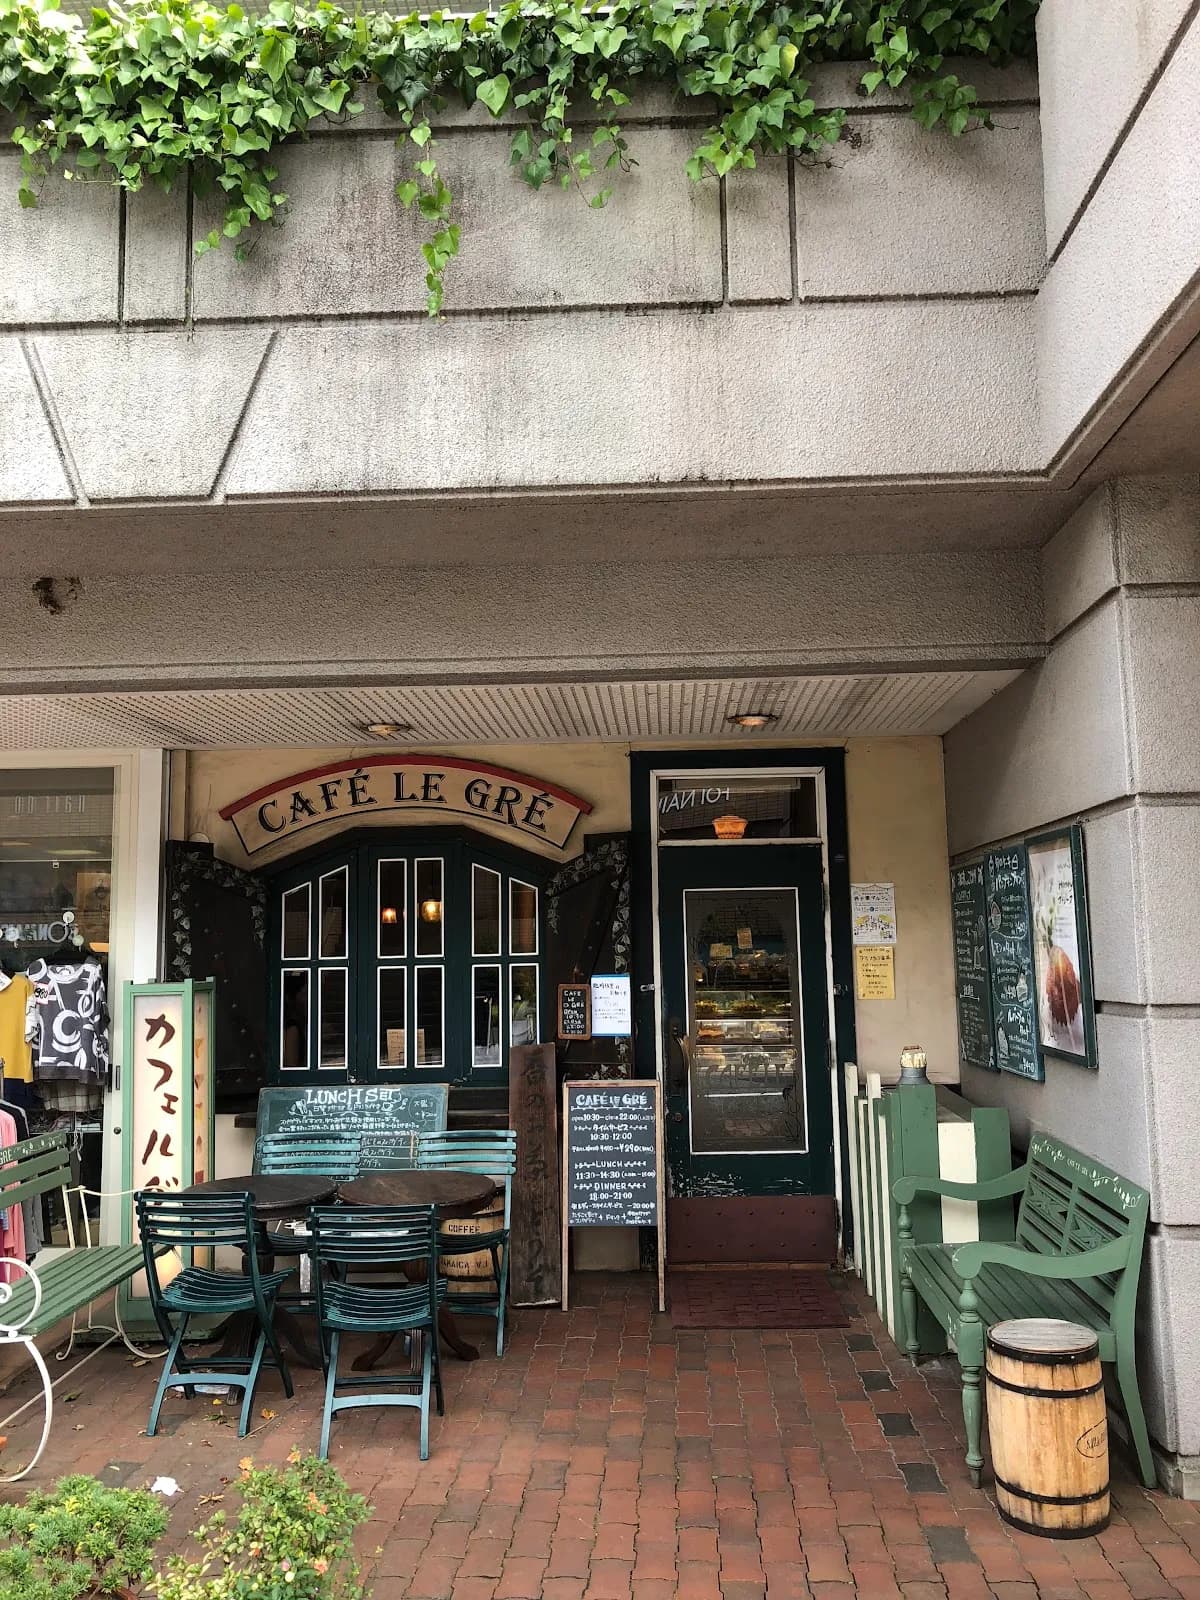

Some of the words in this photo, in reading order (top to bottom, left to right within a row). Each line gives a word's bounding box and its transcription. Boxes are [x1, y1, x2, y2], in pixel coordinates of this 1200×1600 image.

[257, 768, 378, 834] CAFÉ
[393, 771, 447, 804] LE
[464, 777, 555, 833] GRÉ
[305, 1088, 364, 1105] LUNCH
[365, 1087, 401, 1102] SET
[575, 1091, 608, 1106] CAFÉ
[622, 1090, 648, 1105] GRÉ
[595, 1159, 623, 1168] LUNCH
[594, 1182, 627, 1192] DINNER
[448, 1223, 480, 1234] COFFEE
